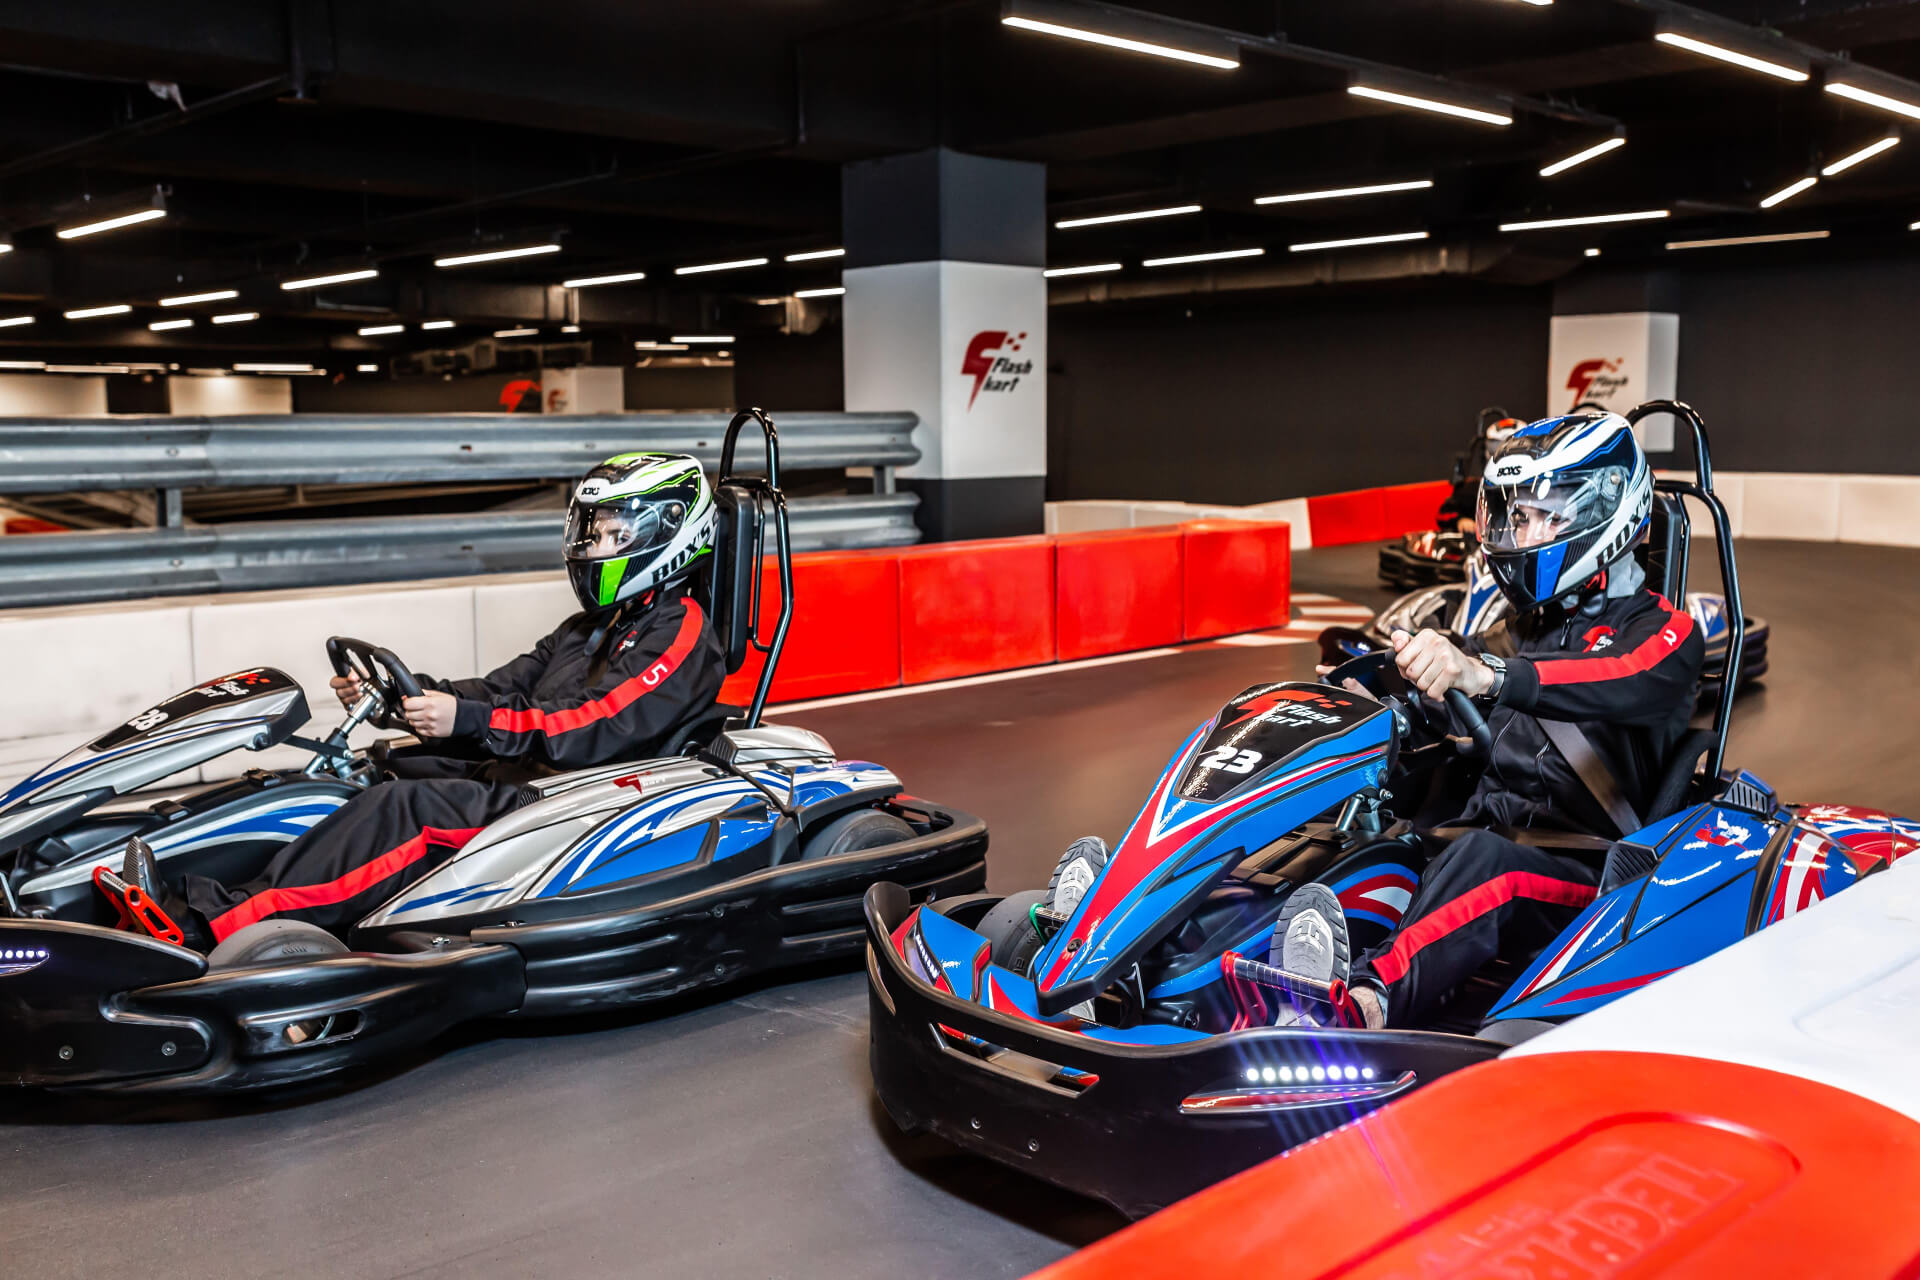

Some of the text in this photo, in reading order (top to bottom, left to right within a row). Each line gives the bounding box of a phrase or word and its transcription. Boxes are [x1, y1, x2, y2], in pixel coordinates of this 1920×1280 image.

[992, 357, 1032, 374] Flash
[983, 376, 1019, 392] kart
[642, 663, 668, 685] 5
[1257, 714, 1313, 727] art
[1200, 745, 1263, 774] 23
